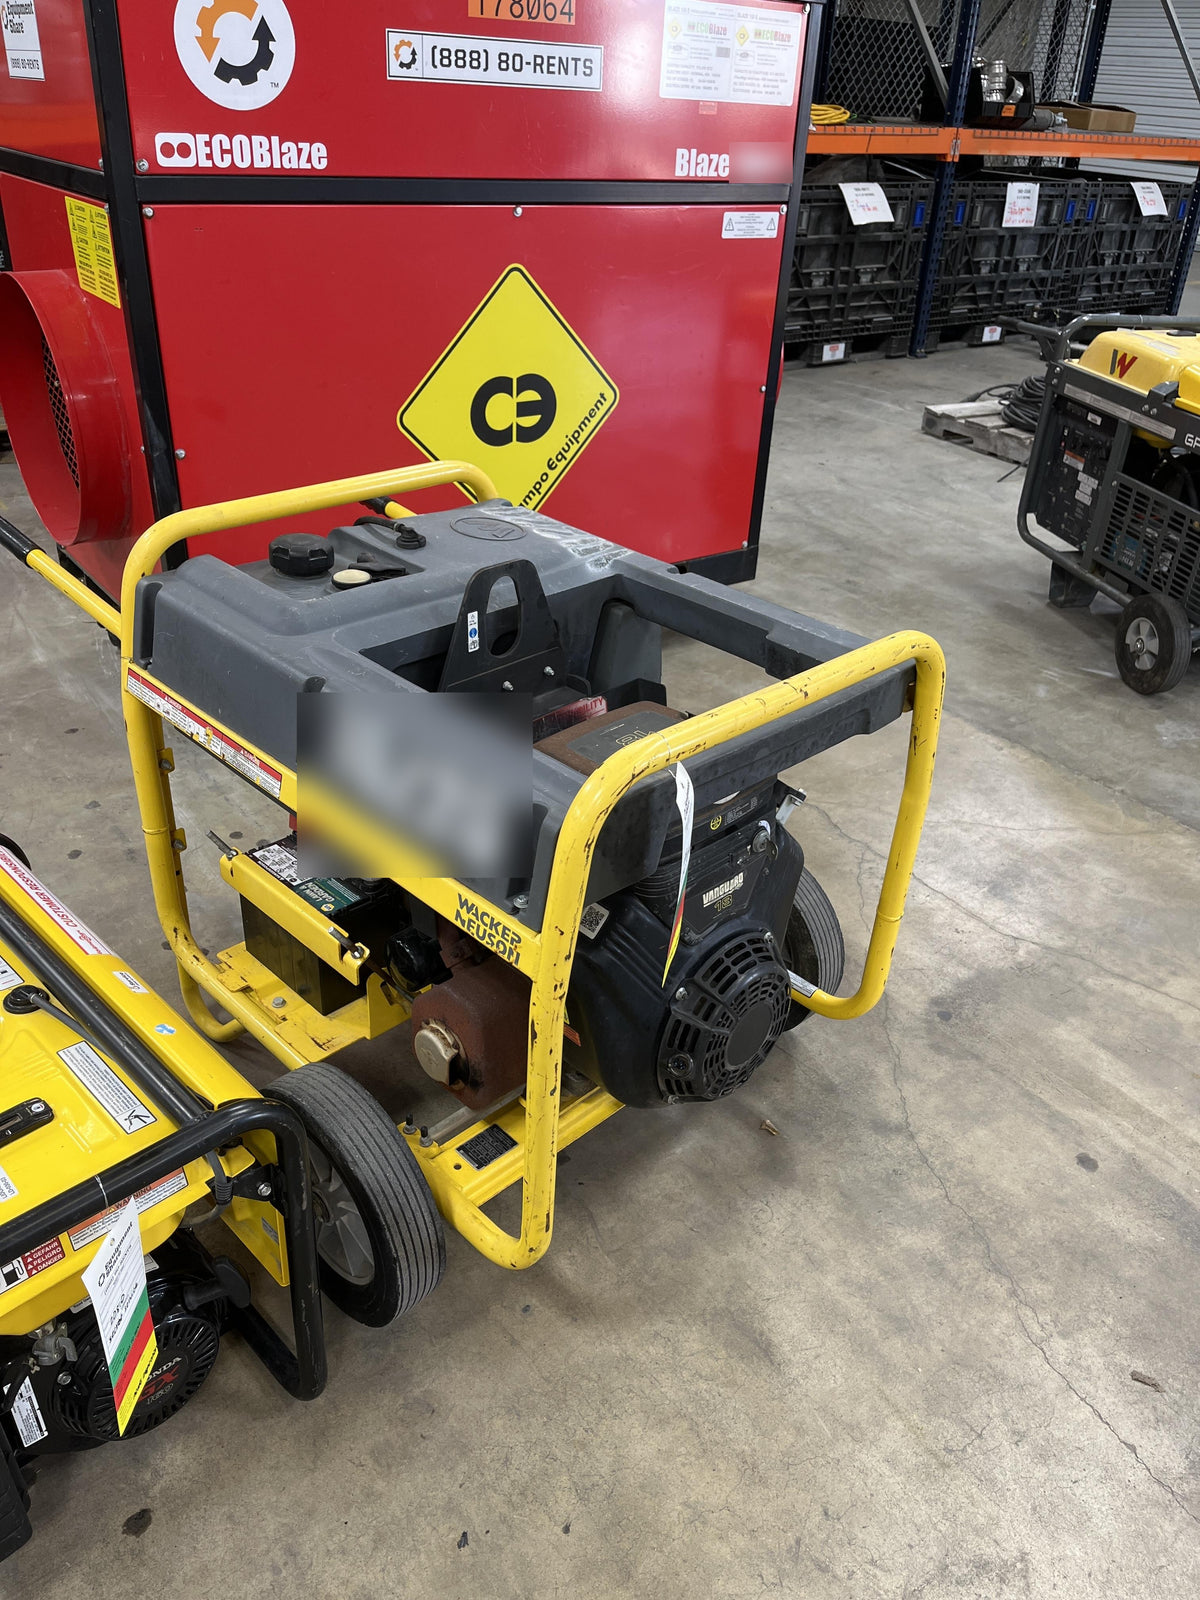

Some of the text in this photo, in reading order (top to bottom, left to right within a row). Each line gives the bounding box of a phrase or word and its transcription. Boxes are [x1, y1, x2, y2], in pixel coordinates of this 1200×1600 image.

[431, 45, 594, 78] (888) 80-RENTS
[195, 133, 328, 170] ECOBlaze
[674, 147, 730, 178] Blaze
[519, 391, 608, 508] mpo Equipment
[702, 872, 744, 905] VANGUARD
[36, 891, 78, 928] CUSTOMER
[457, 892, 522, 946] WACKER
[454, 908, 521, 967] NEUSON
[33, 1241, 59, 1259] GEFAHR
[33, 1247, 62, 1266] PELIGRO
[37, 1253, 63, 1271] DANGER
